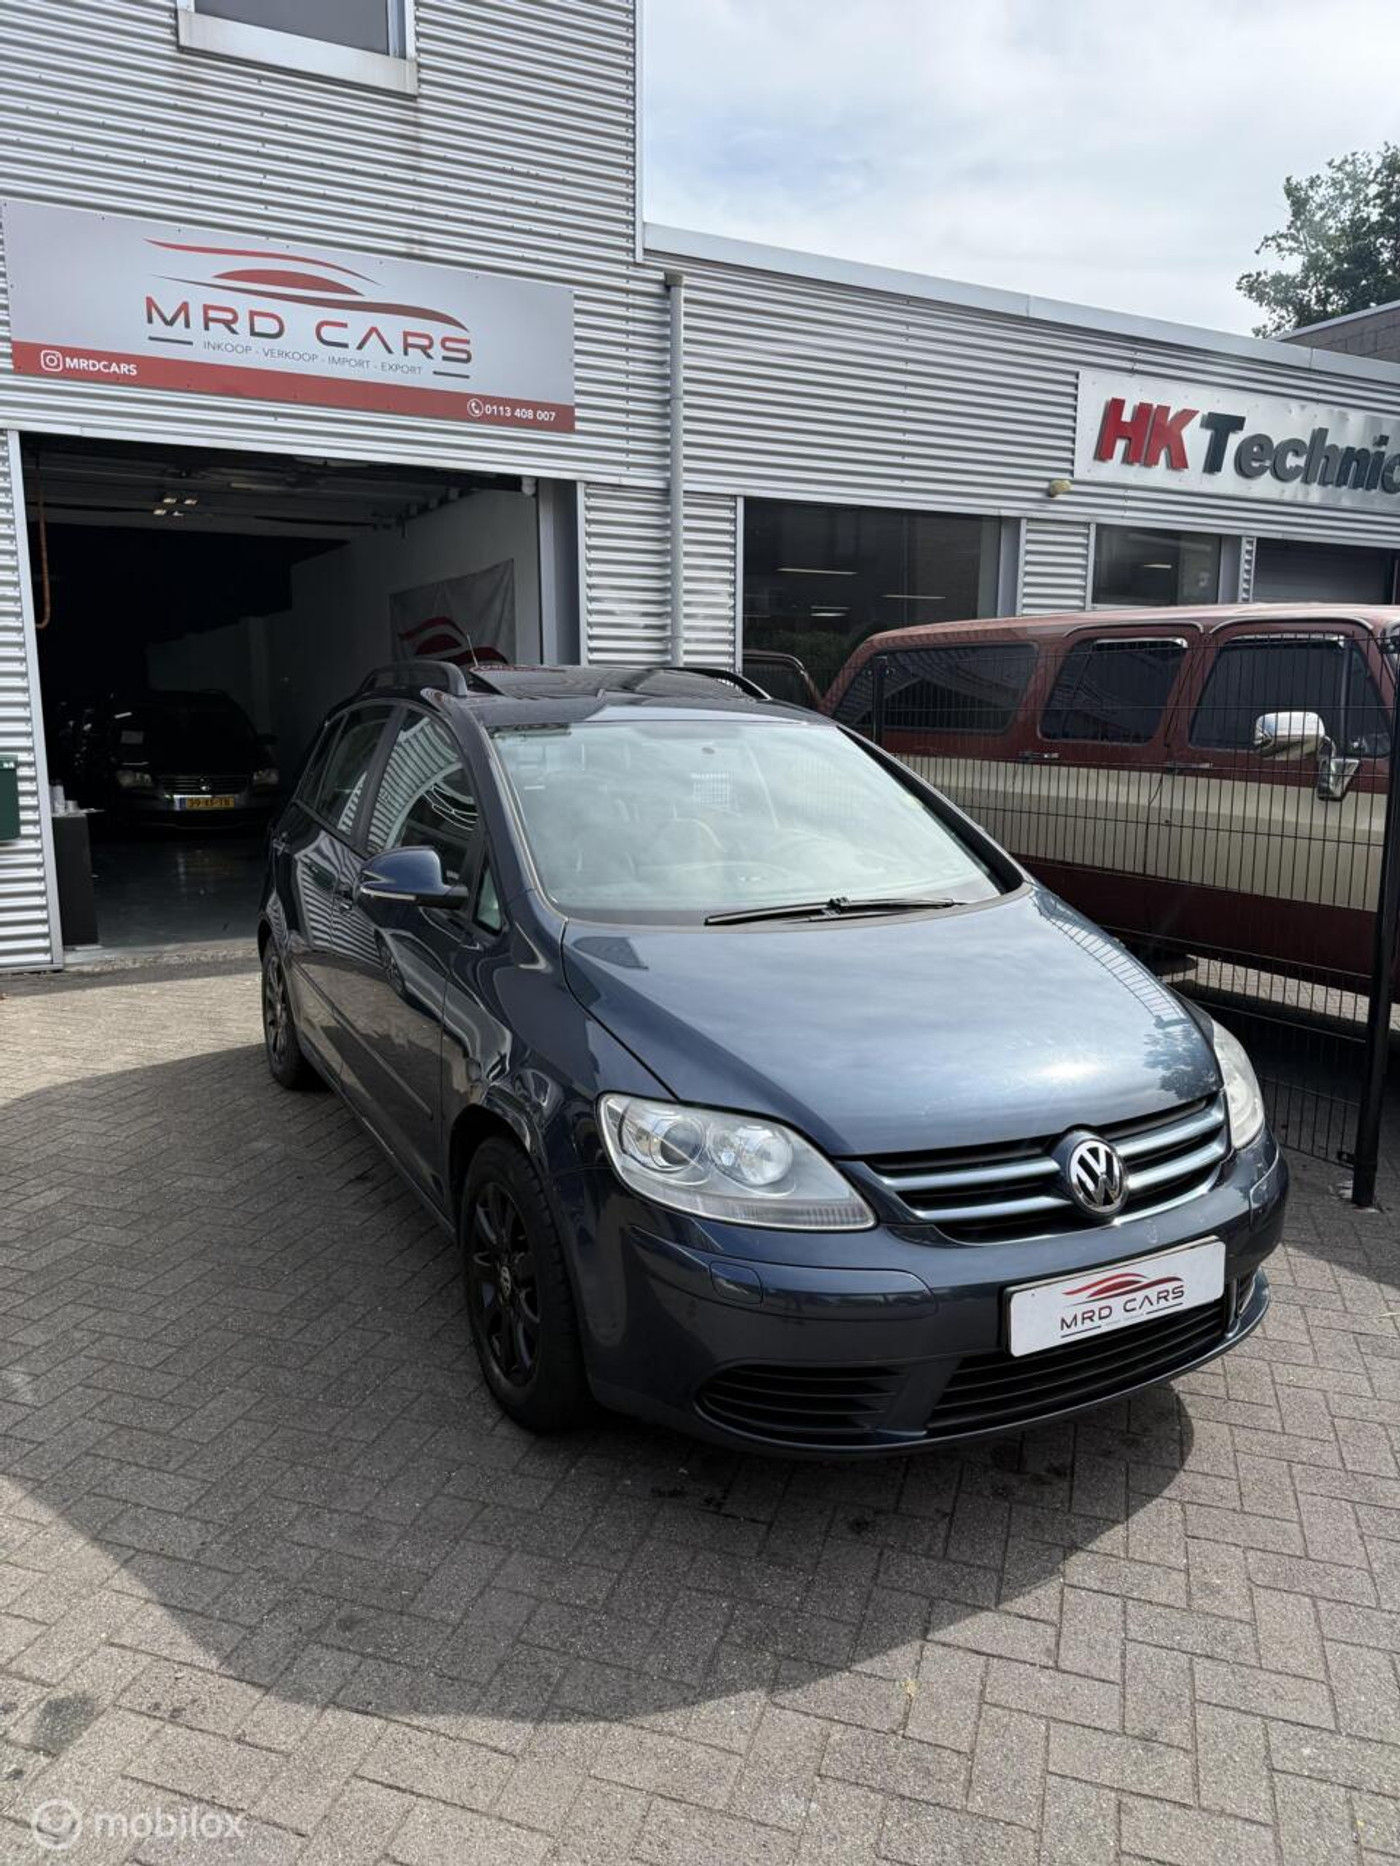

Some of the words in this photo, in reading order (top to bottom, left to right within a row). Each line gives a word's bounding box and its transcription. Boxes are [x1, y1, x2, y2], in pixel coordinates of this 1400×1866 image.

[146, 295, 285, 339] MRD
[315, 320, 472, 364] CARS
[65, 357, 137, 376] MRDCARS
[203, 340, 252, 355] INKOOP
[262, 347, 318, 363] VERKOOP
[328, 356, 370, 370] IMPORT
[380, 362, 422, 375] EXPORT
[485, 404, 512, 417] 0113
[514, 408, 533, 419] 408
[536, 410, 556, 421] 007
[1060, 1305, 1113, 1331] MRD
[1123, 1284, 1185, 1313] CARS
